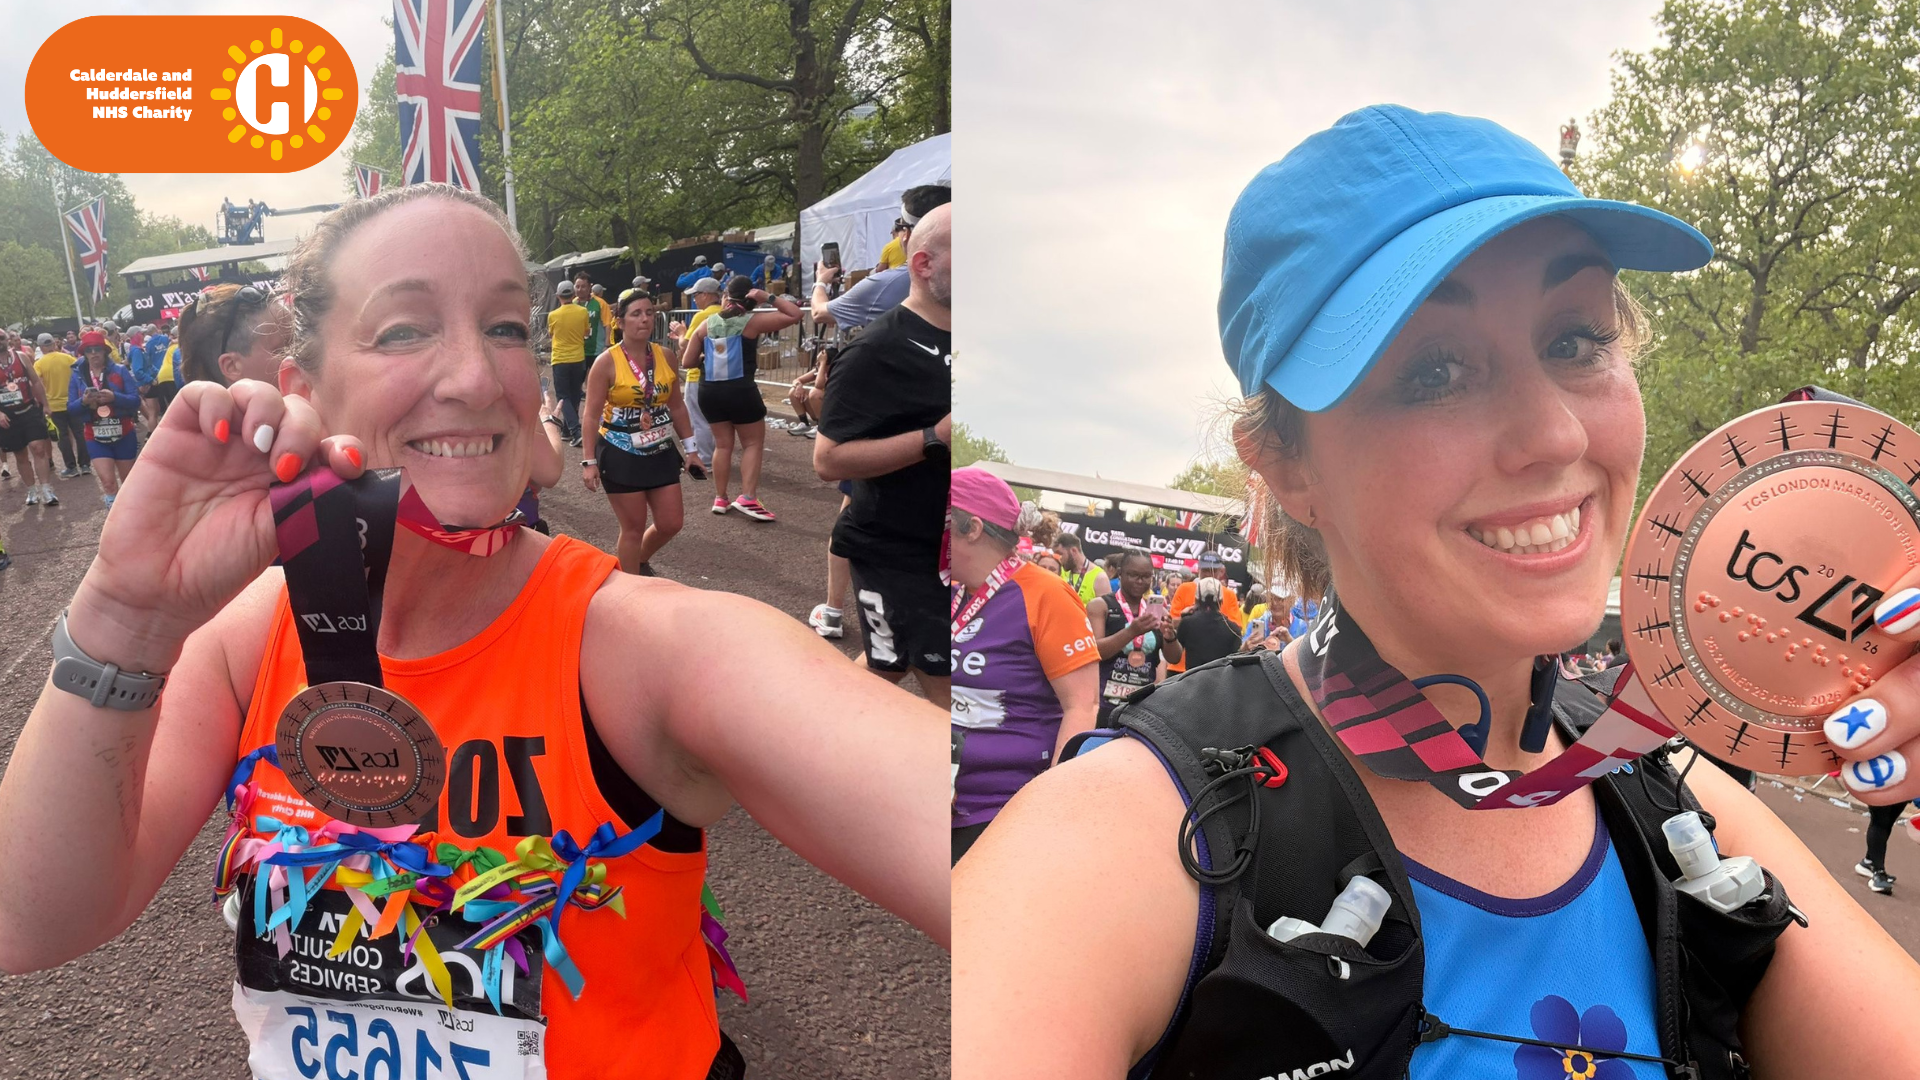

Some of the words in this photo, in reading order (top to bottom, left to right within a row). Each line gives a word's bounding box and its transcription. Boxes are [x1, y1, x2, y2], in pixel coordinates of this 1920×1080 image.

[1742, 491, 1770, 513] TCS
[1771, 478, 1831, 498] LONDON
[1832, 480, 1903, 533] MARATHON
[1085, 527, 1109, 546] tcs
[1150, 534, 1176, 555] tcs
[1217, 543, 1242, 563] tcs
[1726, 529, 1810, 604] tcs
[1816, 564, 1835, 579] 20
[1862, 641, 1879, 655] 26
[961, 597, 985, 622] 2026
[1112, 670, 1128, 682] tcs
[1811, 690, 1842, 708] 2026
[1259, 1048, 1355, 1080] MON
